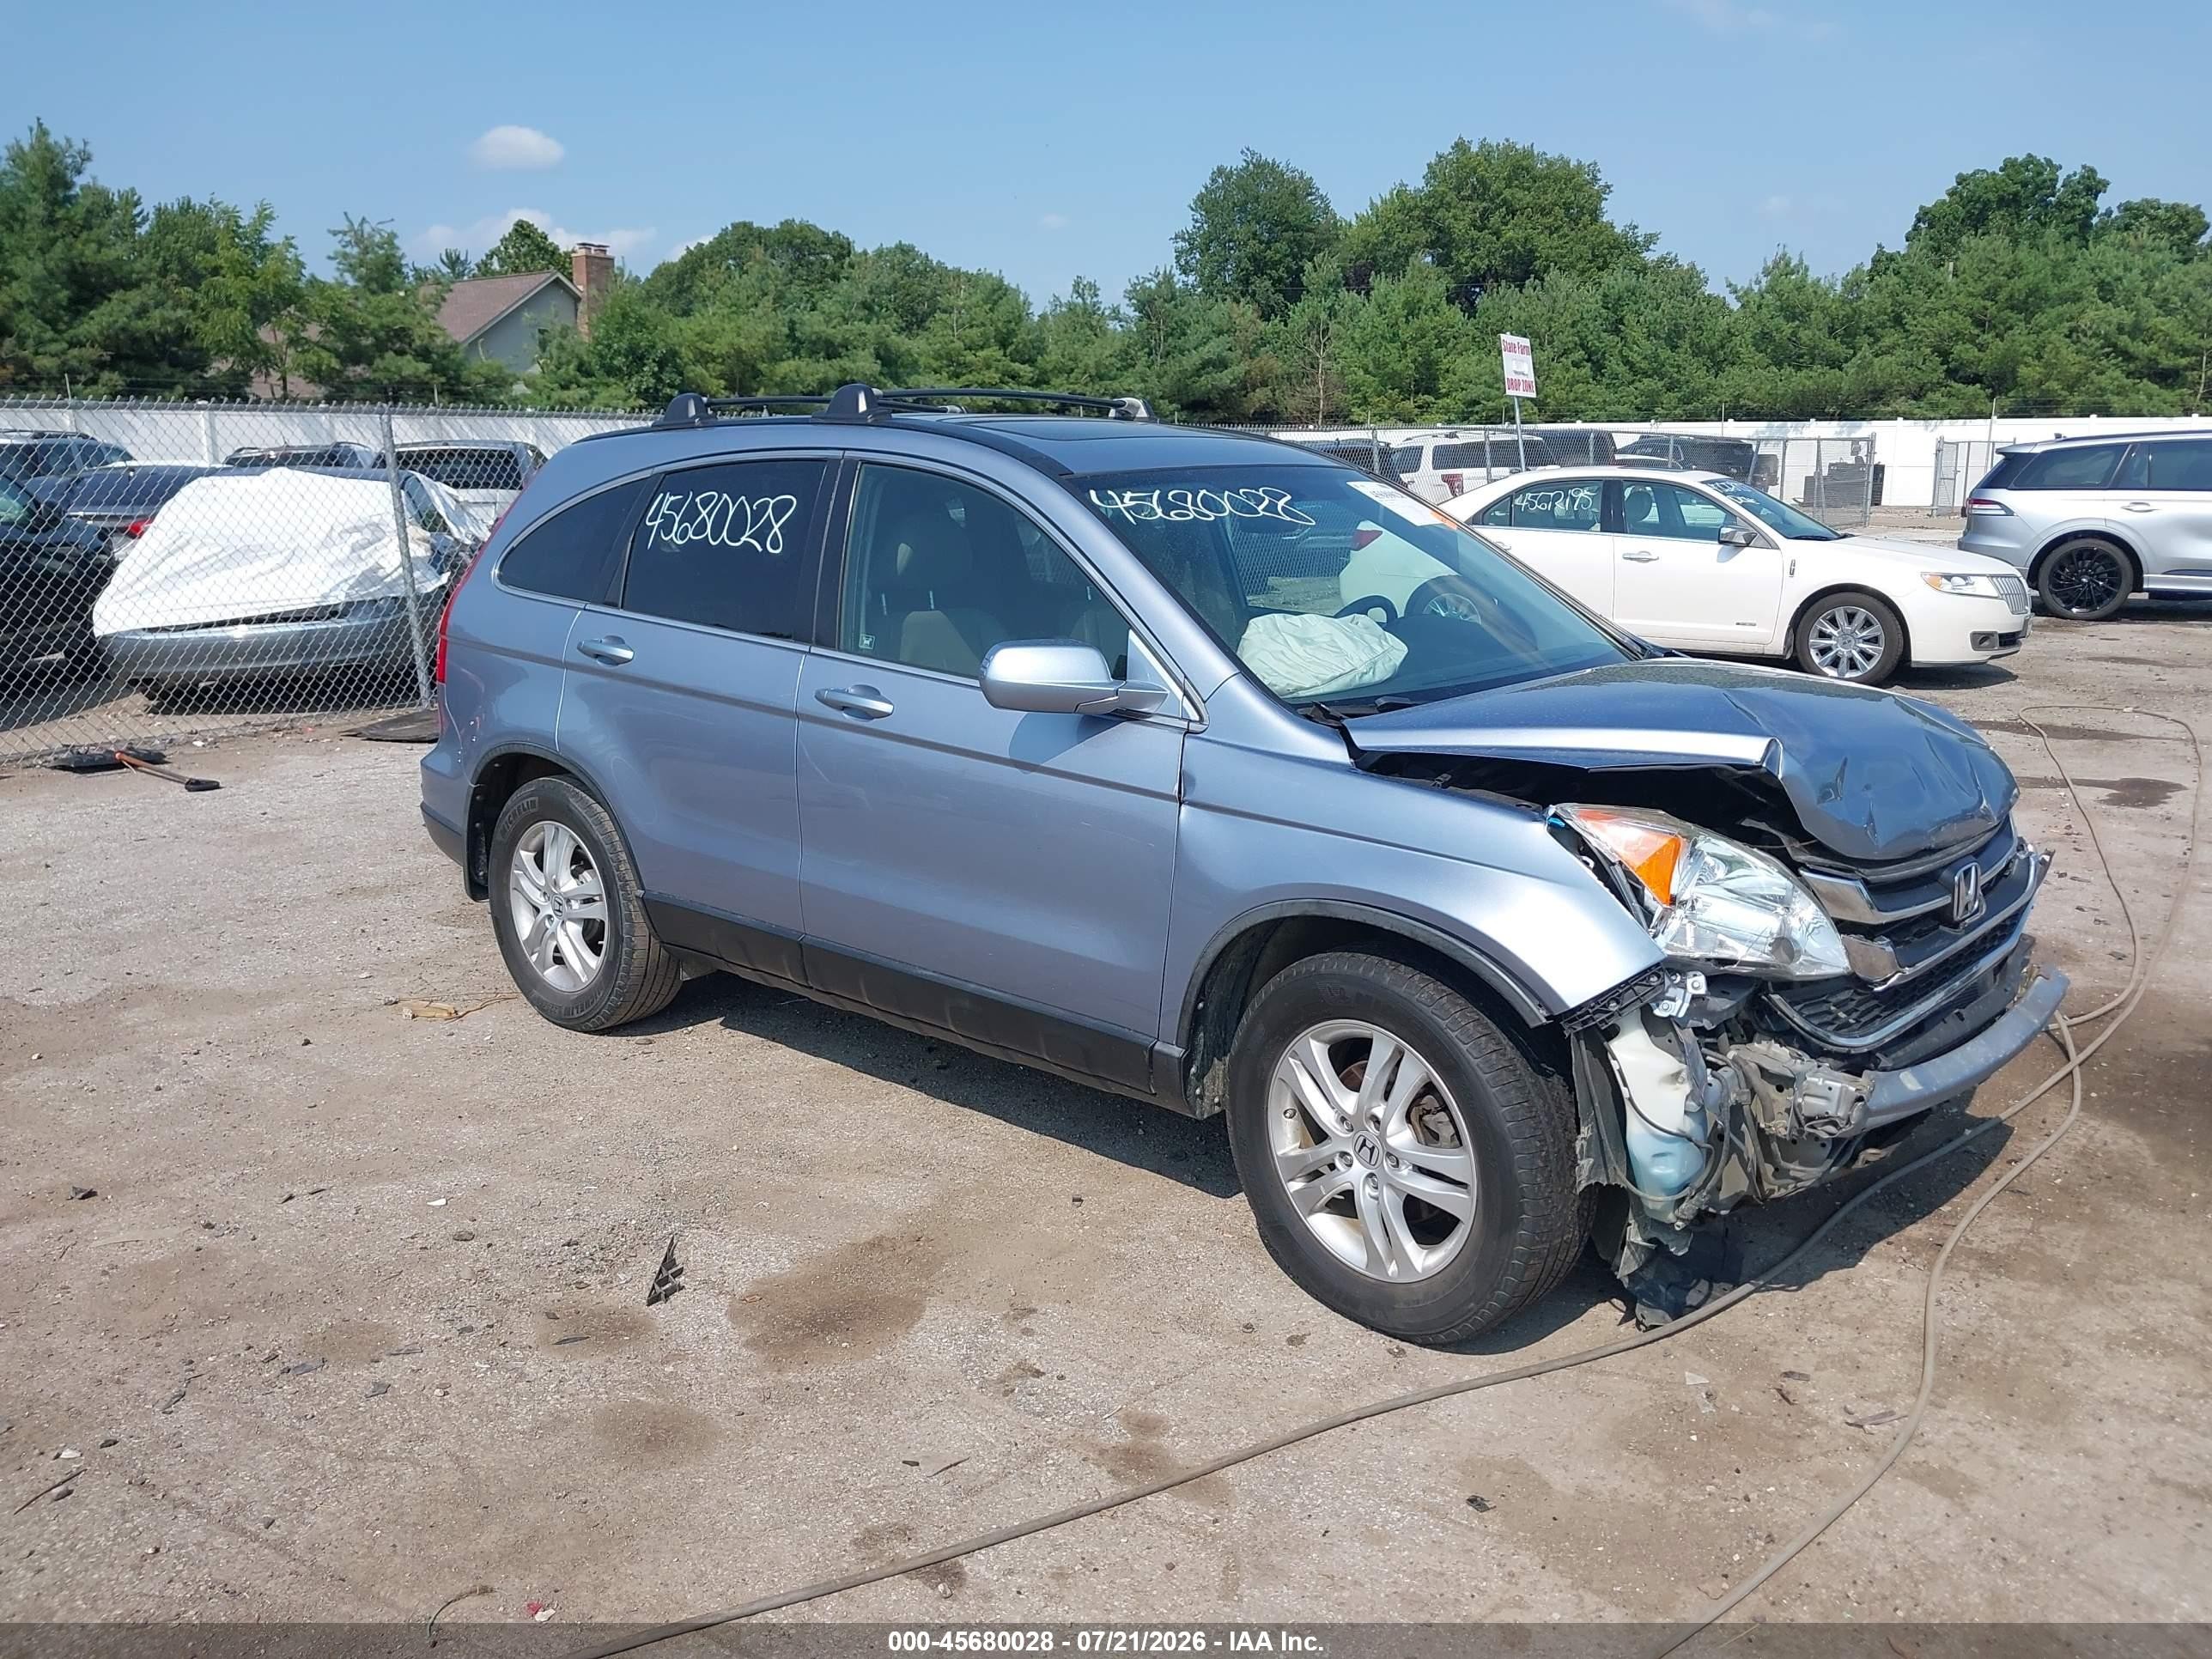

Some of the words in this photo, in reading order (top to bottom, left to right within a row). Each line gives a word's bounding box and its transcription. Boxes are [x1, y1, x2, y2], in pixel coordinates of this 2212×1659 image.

[1502, 339, 1517, 354] State
[1517, 342, 1531, 356] Farm
[1506, 378, 1522, 392] DROP
[1522, 380, 1535, 393] ZONE
[1089, 487, 1316, 526] 45680028
[645, 491, 798, 554] 45680028
